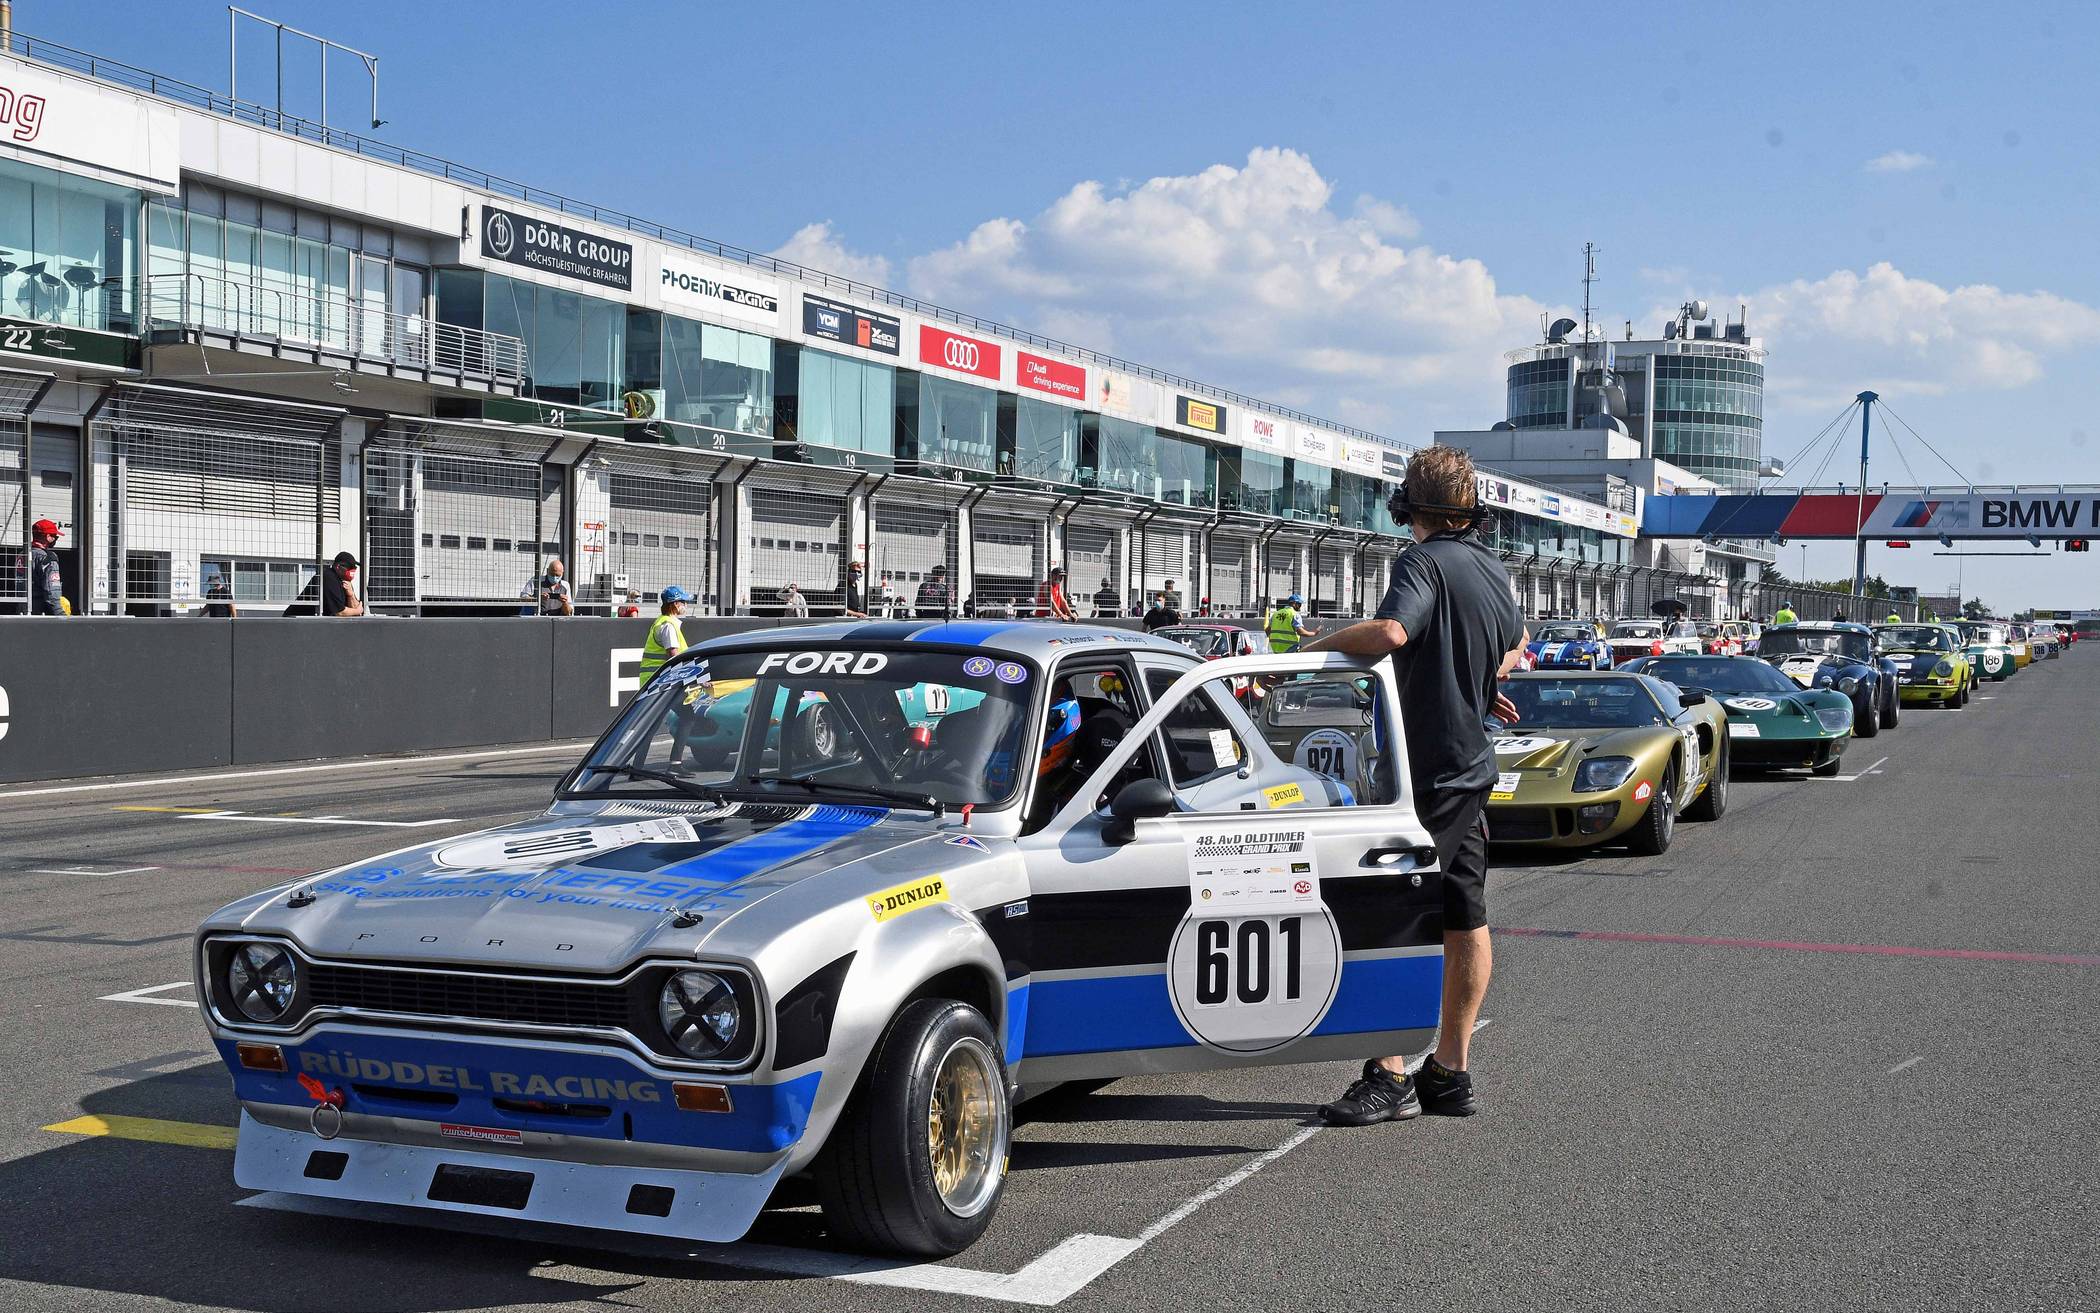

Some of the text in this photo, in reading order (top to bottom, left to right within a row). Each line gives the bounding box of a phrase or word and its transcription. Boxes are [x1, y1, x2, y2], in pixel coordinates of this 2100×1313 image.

[525, 223, 630, 268] DÖRR GROUP
[525, 250, 629, 286] HÖCHSTLEISTUNG ERFAHREN.
[819, 312, 839, 329] YCM
[4, 324, 33, 351] 22
[1033, 363, 1047, 374] Audi
[1033, 375, 1080, 394] driving experience
[550, 408, 565, 428] 21
[1191, 406, 1214, 425] PIRELLI
[1253, 418, 1274, 438] ROWE
[712, 433, 726, 450] 20
[1303, 436, 1326, 452] SCHERER
[845, 453, 856, 469] 19
[954, 471, 963, 483] 18
[1981, 500, 2081, 528] BMW
[756, 651, 889, 675] FORD
[1984, 654, 2000, 666] 186
[1307, 747, 1345, 780] 924
[1273, 788, 1300, 802] DUNLOP
[1196, 831, 1305, 846] 48. AvD OLDTIMER
[1241, 842, 1292, 854] GRAND PRIX
[318, 882, 373, 898] Safe
[376, 888, 494, 898] solutions
[537, 891, 603, 906] your
[885, 881, 942, 911] DUNLOP
[358, 933, 574, 951] FORD
[1195, 916, 1302, 1006] 601
[300, 1050, 662, 1102] RÜDDEL RACING
[442, 1126, 520, 1142] zwischengas.com
